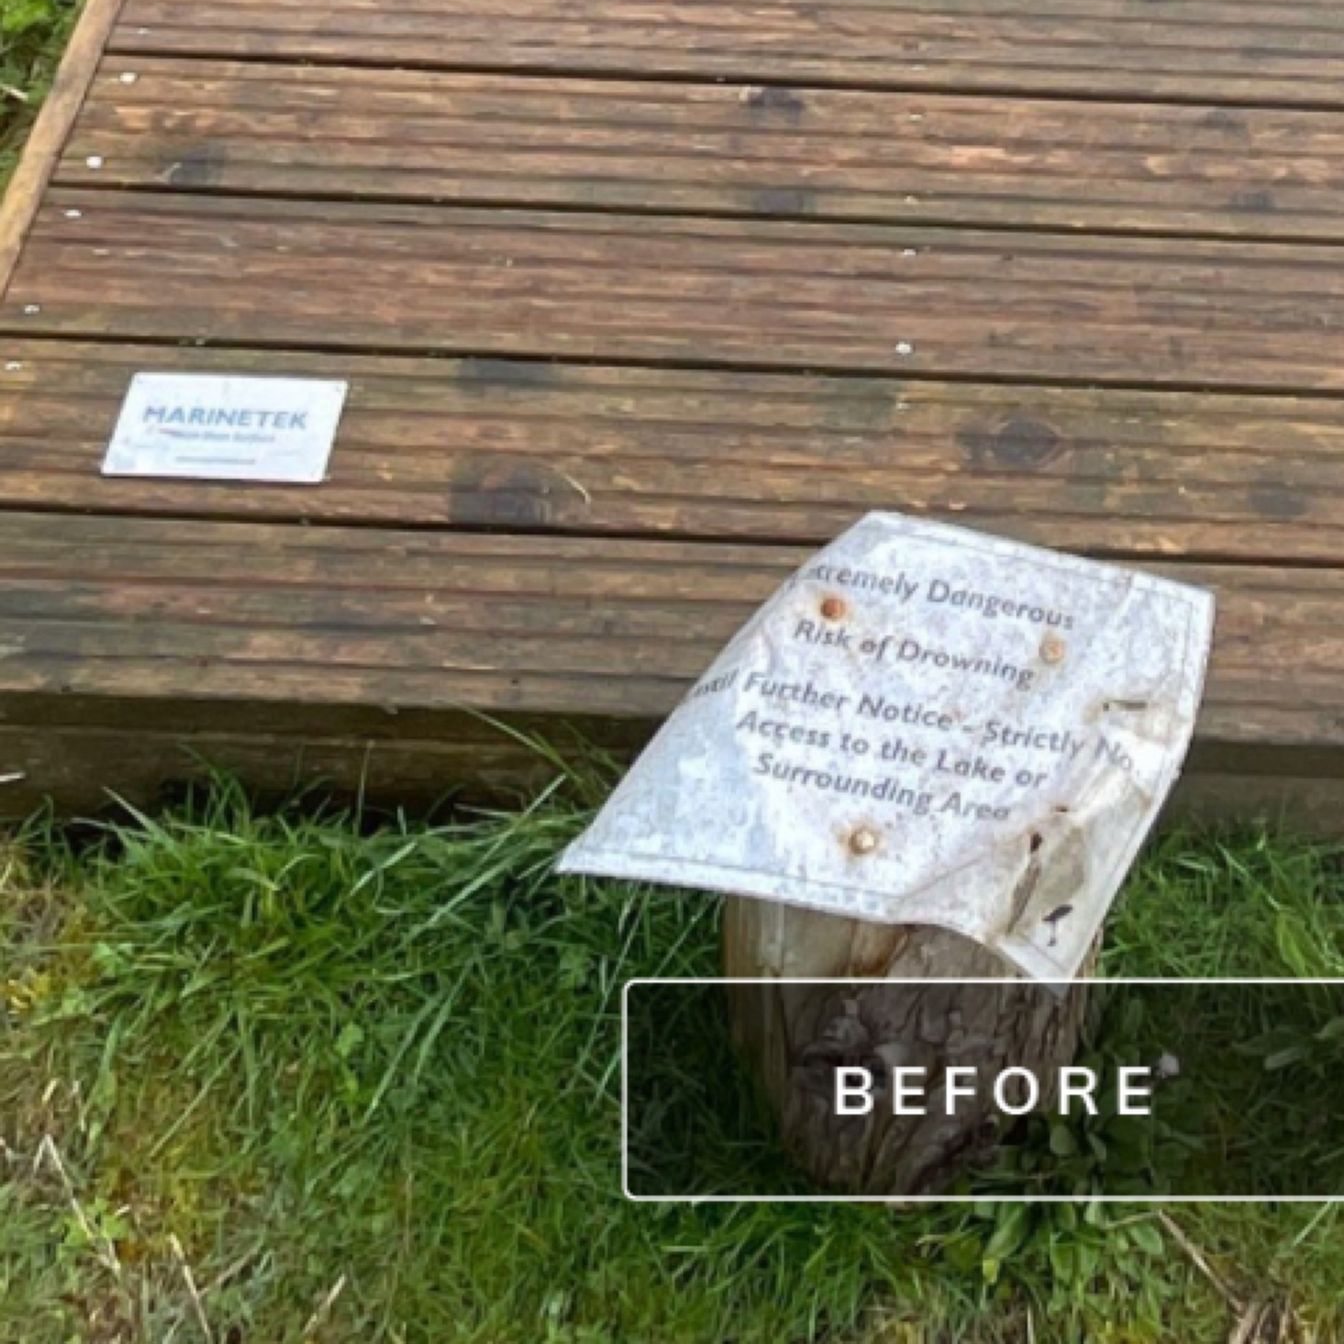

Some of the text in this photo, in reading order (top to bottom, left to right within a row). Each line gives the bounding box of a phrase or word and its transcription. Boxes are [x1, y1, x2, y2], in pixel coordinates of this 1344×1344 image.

[142, 405, 310, 430] MARINETEK
[926, 579, 1074, 630] Dangerous
[793, 619, 1035, 692] Risk of Drowning
[736, 710, 1048, 788] Access to the Lake or
[743, 672, 851, 712] Further
[856, 692, 953, 731] Notice
[980, 719, 1084, 760] Strictly
[753, 752, 1012, 821] Surrounding Area
